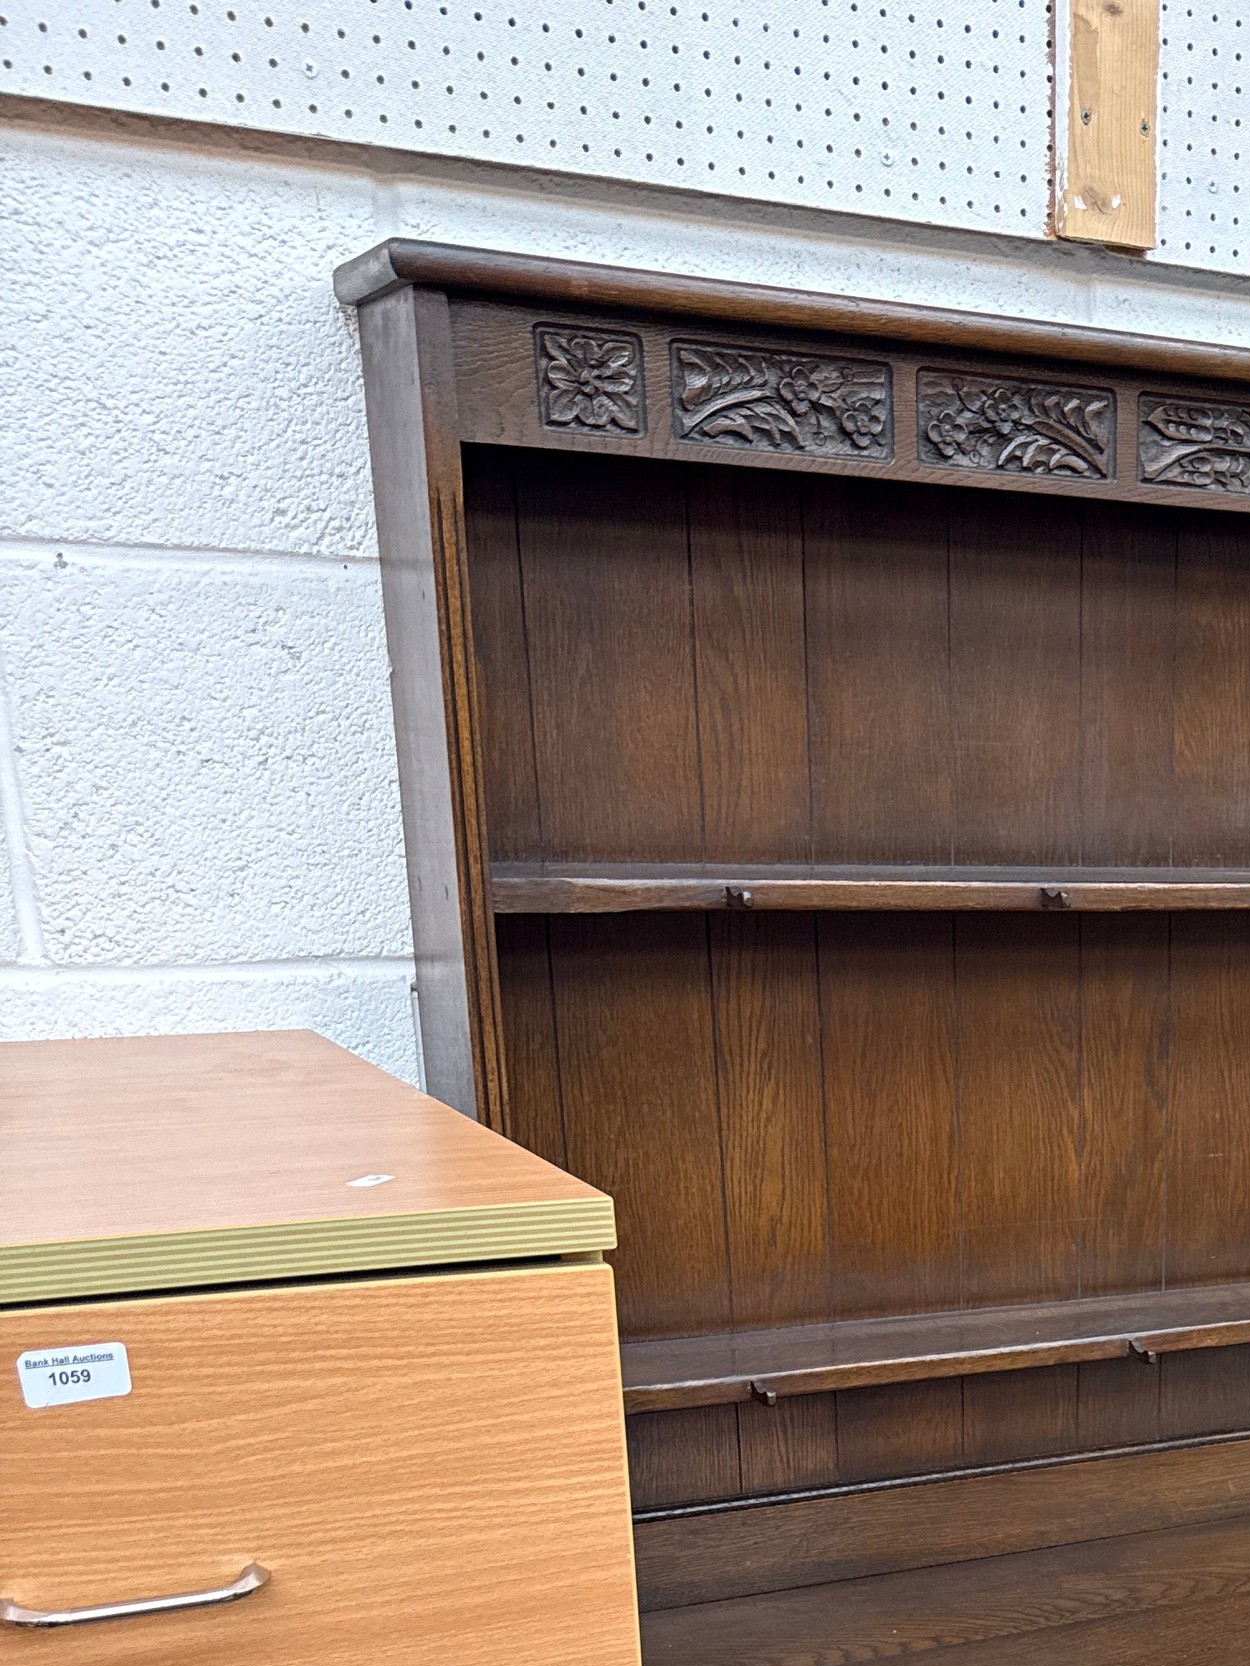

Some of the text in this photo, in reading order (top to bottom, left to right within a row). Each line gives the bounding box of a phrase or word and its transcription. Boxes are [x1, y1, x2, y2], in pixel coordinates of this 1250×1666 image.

[25, 1352, 114, 1368] Bank Hall Auctions
[48, 1369, 91, 1386] 1059
